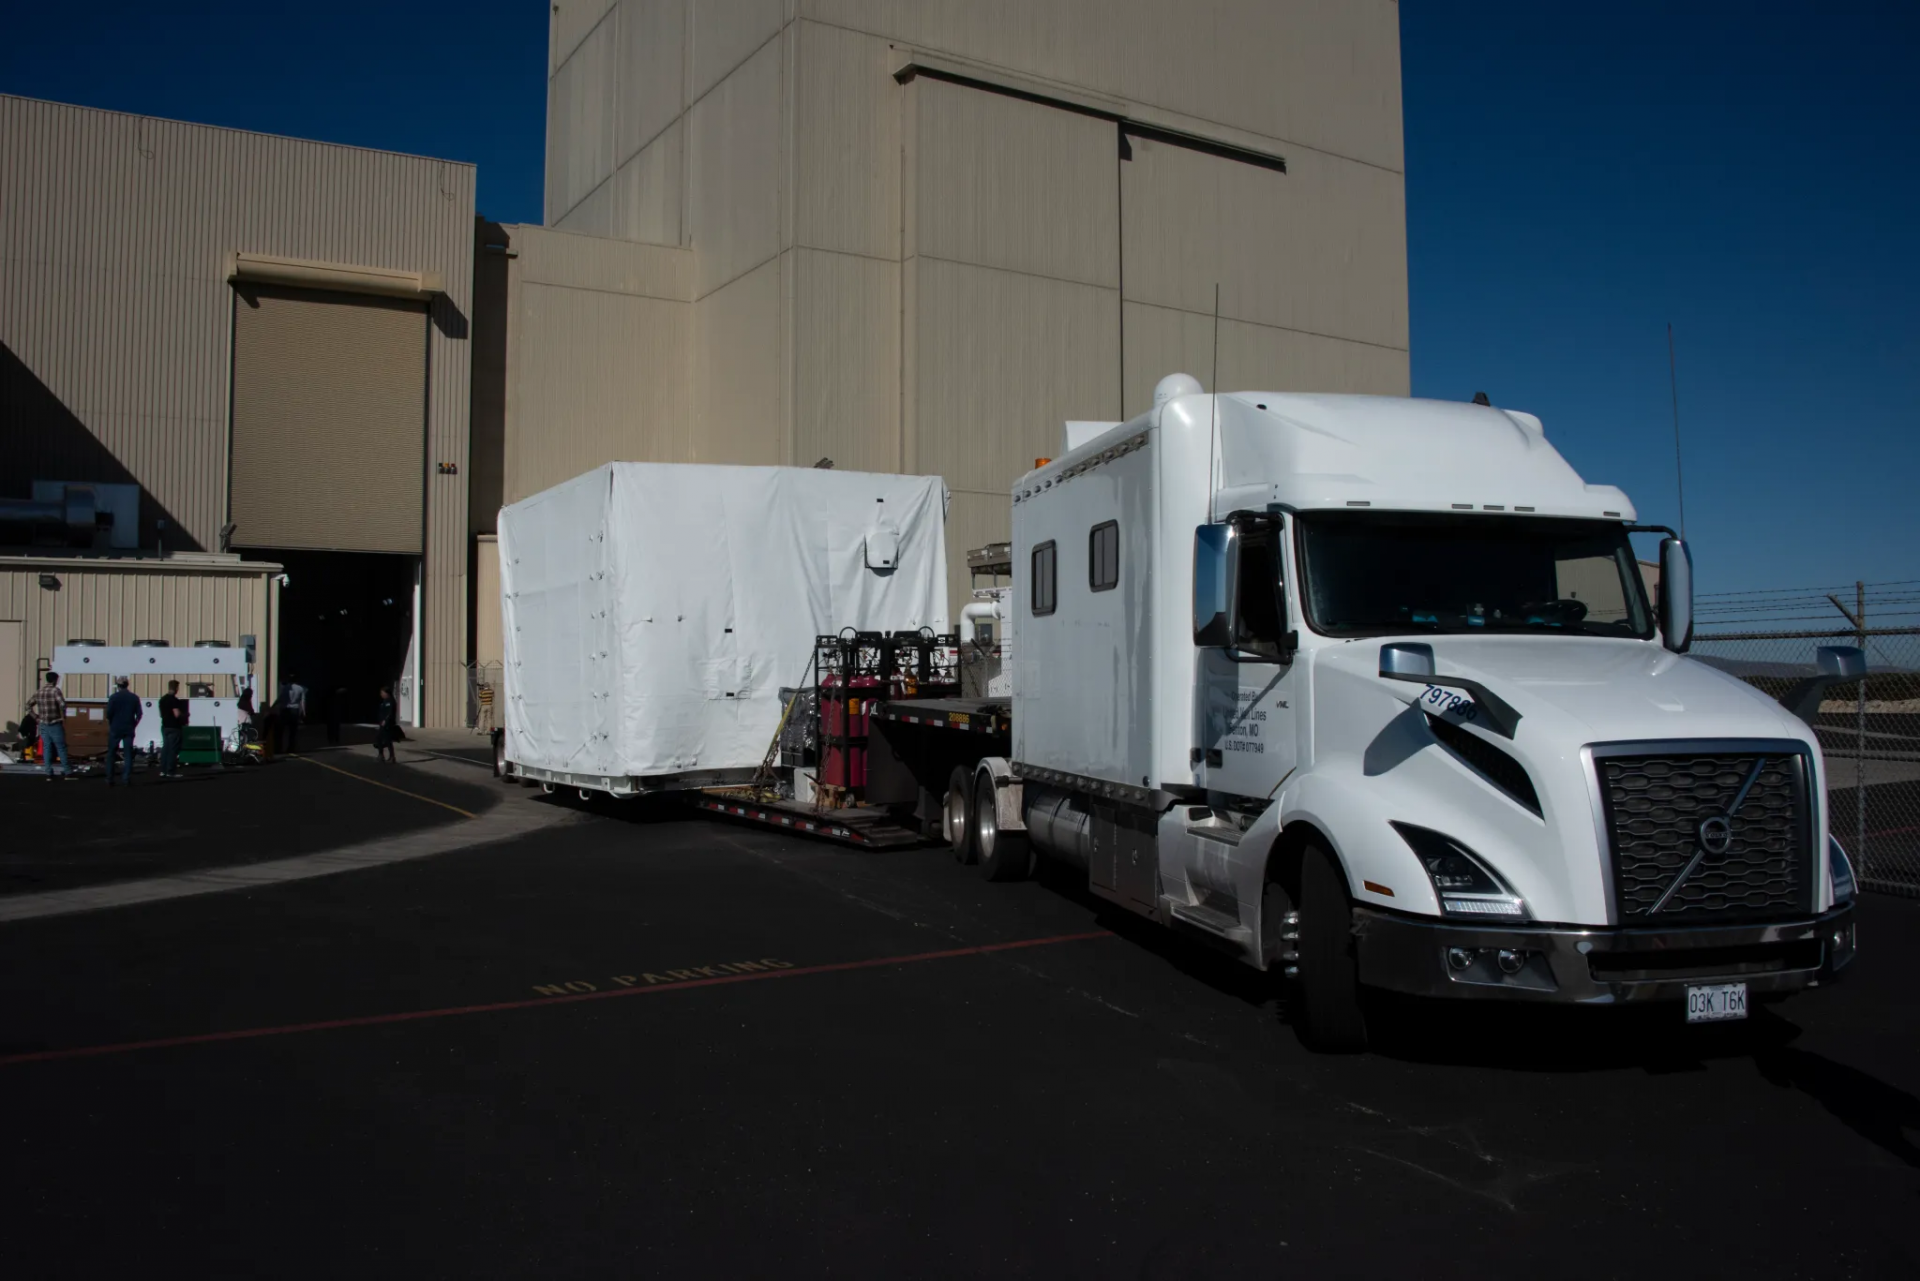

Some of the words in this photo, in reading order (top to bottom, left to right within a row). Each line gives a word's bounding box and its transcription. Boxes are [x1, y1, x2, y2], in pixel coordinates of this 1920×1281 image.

[1419, 683, 1478, 721] 797886
[1251, 707, 1267, 721] Lines
[1249, 723, 1259, 737] MO
[531, 979, 598, 996] NO
[610, 957, 795, 987] PARKING
[1689, 992, 1714, 1013] 03K
[1721, 990, 1745, 1012] T6K
